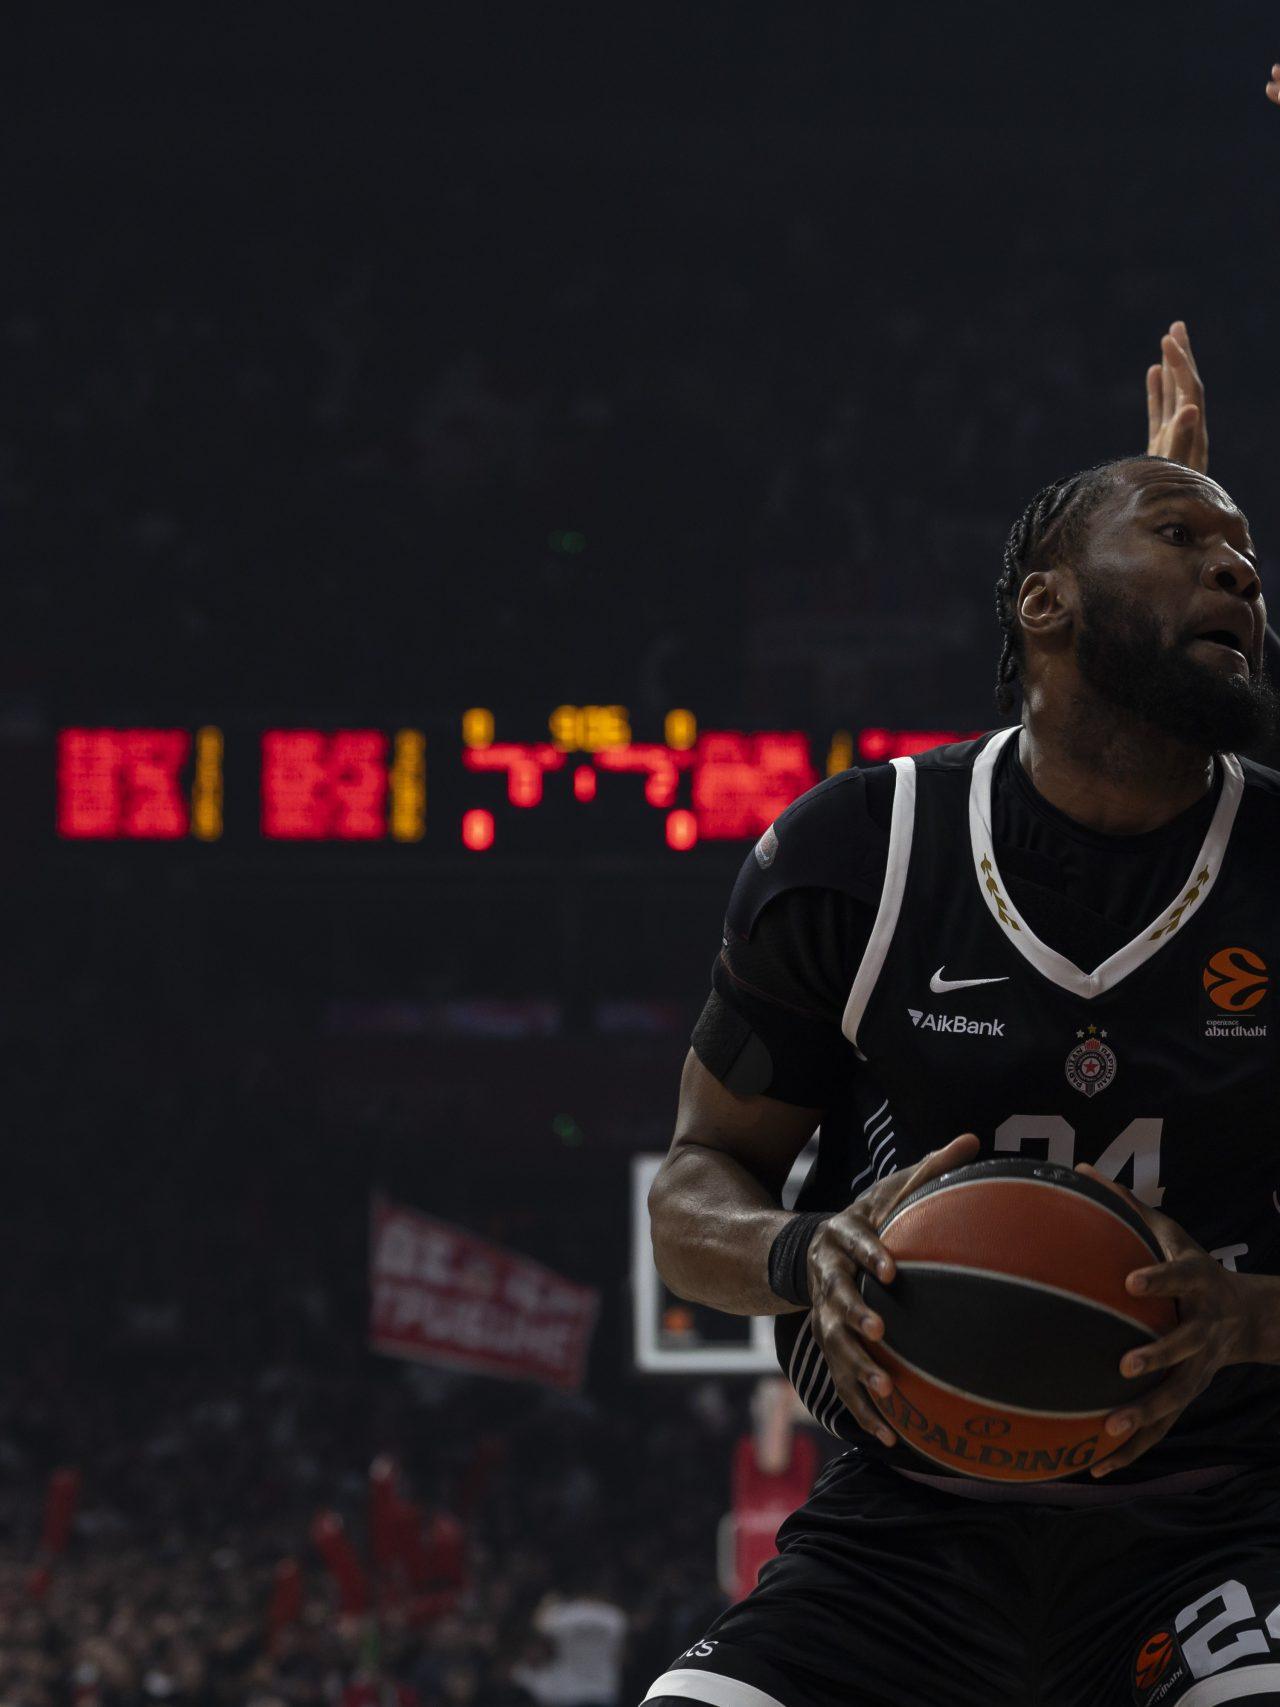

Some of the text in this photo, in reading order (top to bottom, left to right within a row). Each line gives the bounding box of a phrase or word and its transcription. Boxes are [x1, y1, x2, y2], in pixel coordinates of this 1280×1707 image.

[920, 1014, 1006, 1037] AikBank
[1205, 1026, 1267, 1037] abu dhabi
